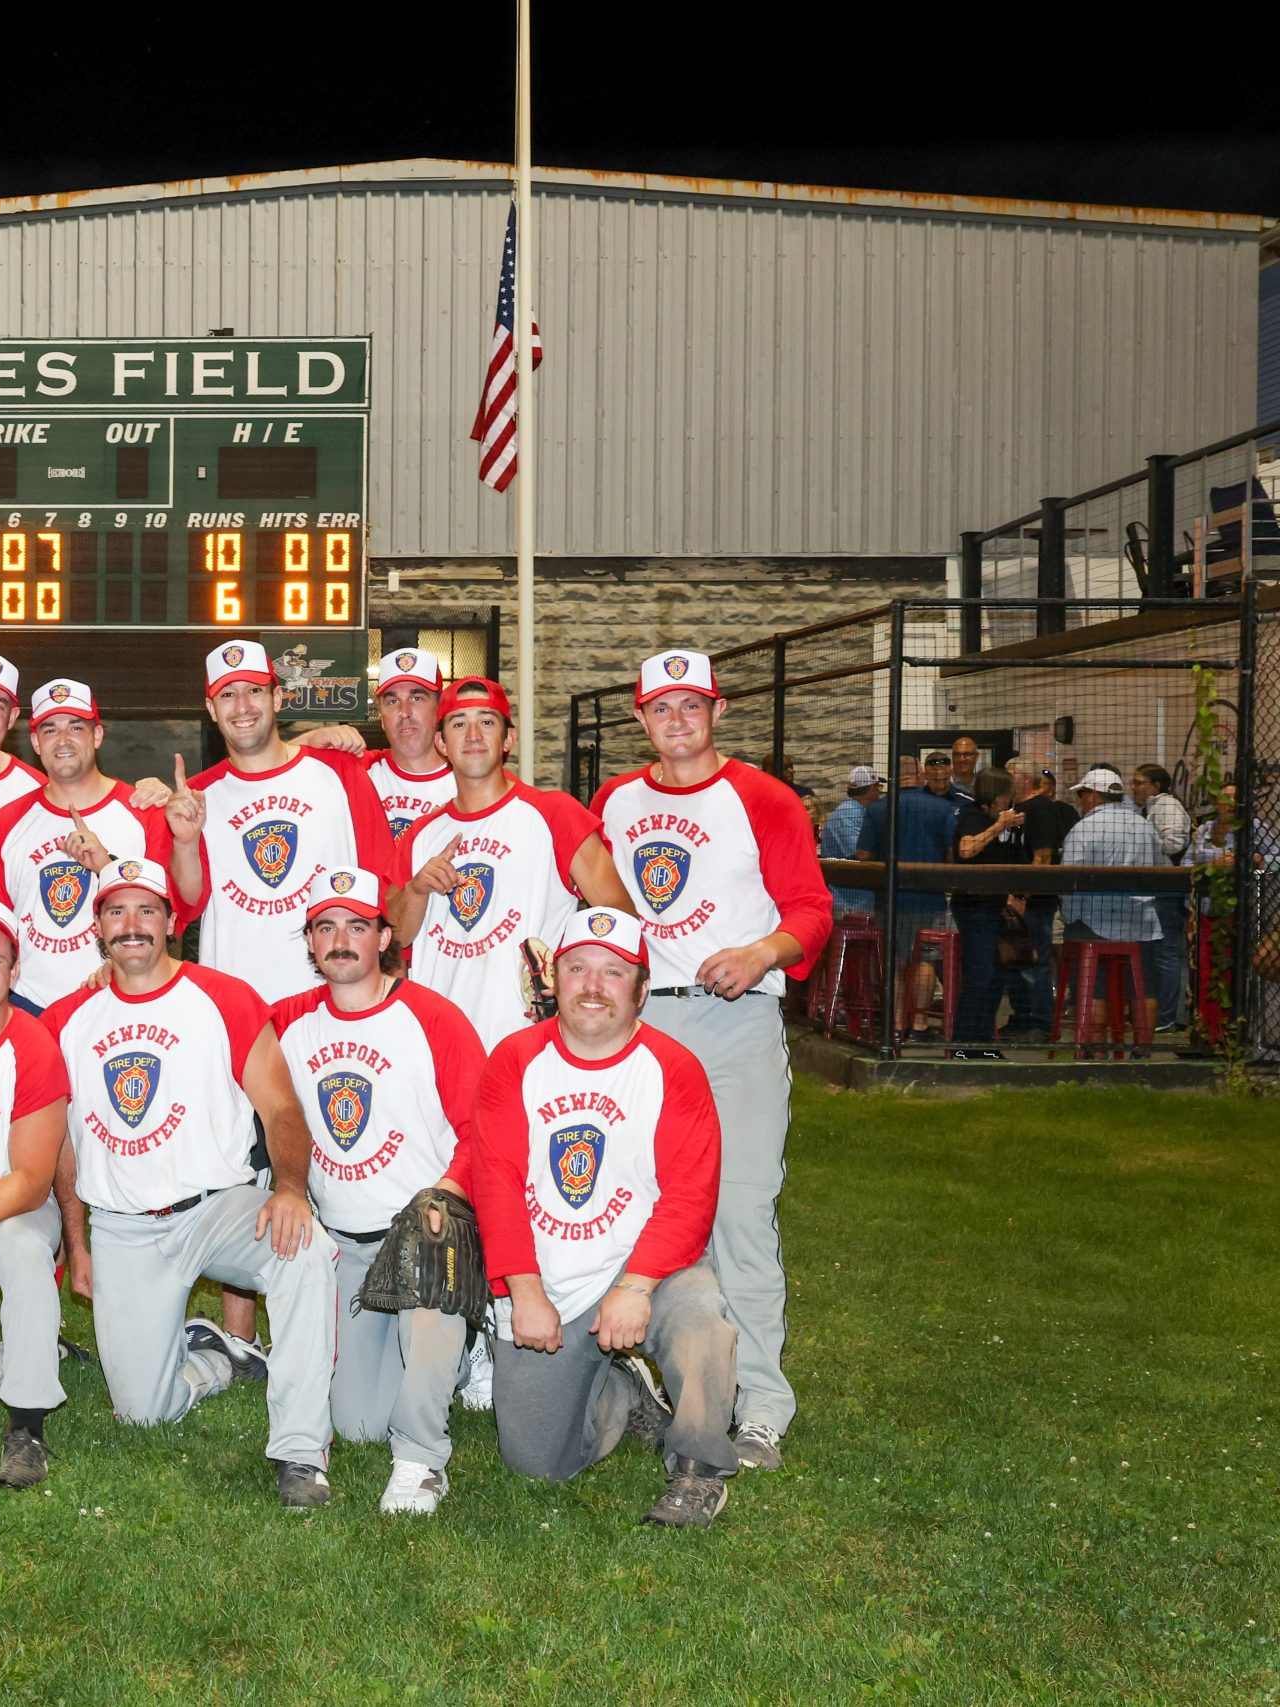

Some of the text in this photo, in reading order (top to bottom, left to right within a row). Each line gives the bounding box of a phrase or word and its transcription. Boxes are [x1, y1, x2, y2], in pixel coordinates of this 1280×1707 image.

[112, 350, 346, 397] FIELD
[105, 423, 161, 443] OUT
[233, 423, 253, 443] H
[284, 423, 303, 443] E
[8, 512, 21, 528] 6
[45, 512, 57, 528] 7
[78, 512, 91, 528] 8
[115, 512, 128, 528] 9
[145, 512, 167, 528] 10
[187, 512, 360, 528] RUNS HITS ERR
[228, 796, 313, 830] NEWPORT
[247, 827, 267, 841] FIRE
[626, 814, 711, 847] NEWPORT
[638, 847, 659, 858] FIRE
[44, 866, 63, 877] FIRE
[92, 1024, 180, 1058] NEWPORT
[108, 1058, 131, 1071] FIRE
[307, 1042, 392, 1075] NEWPORT
[322, 1078, 342, 1091] FIRE
[557, 1131, 580, 1144] FIRE
